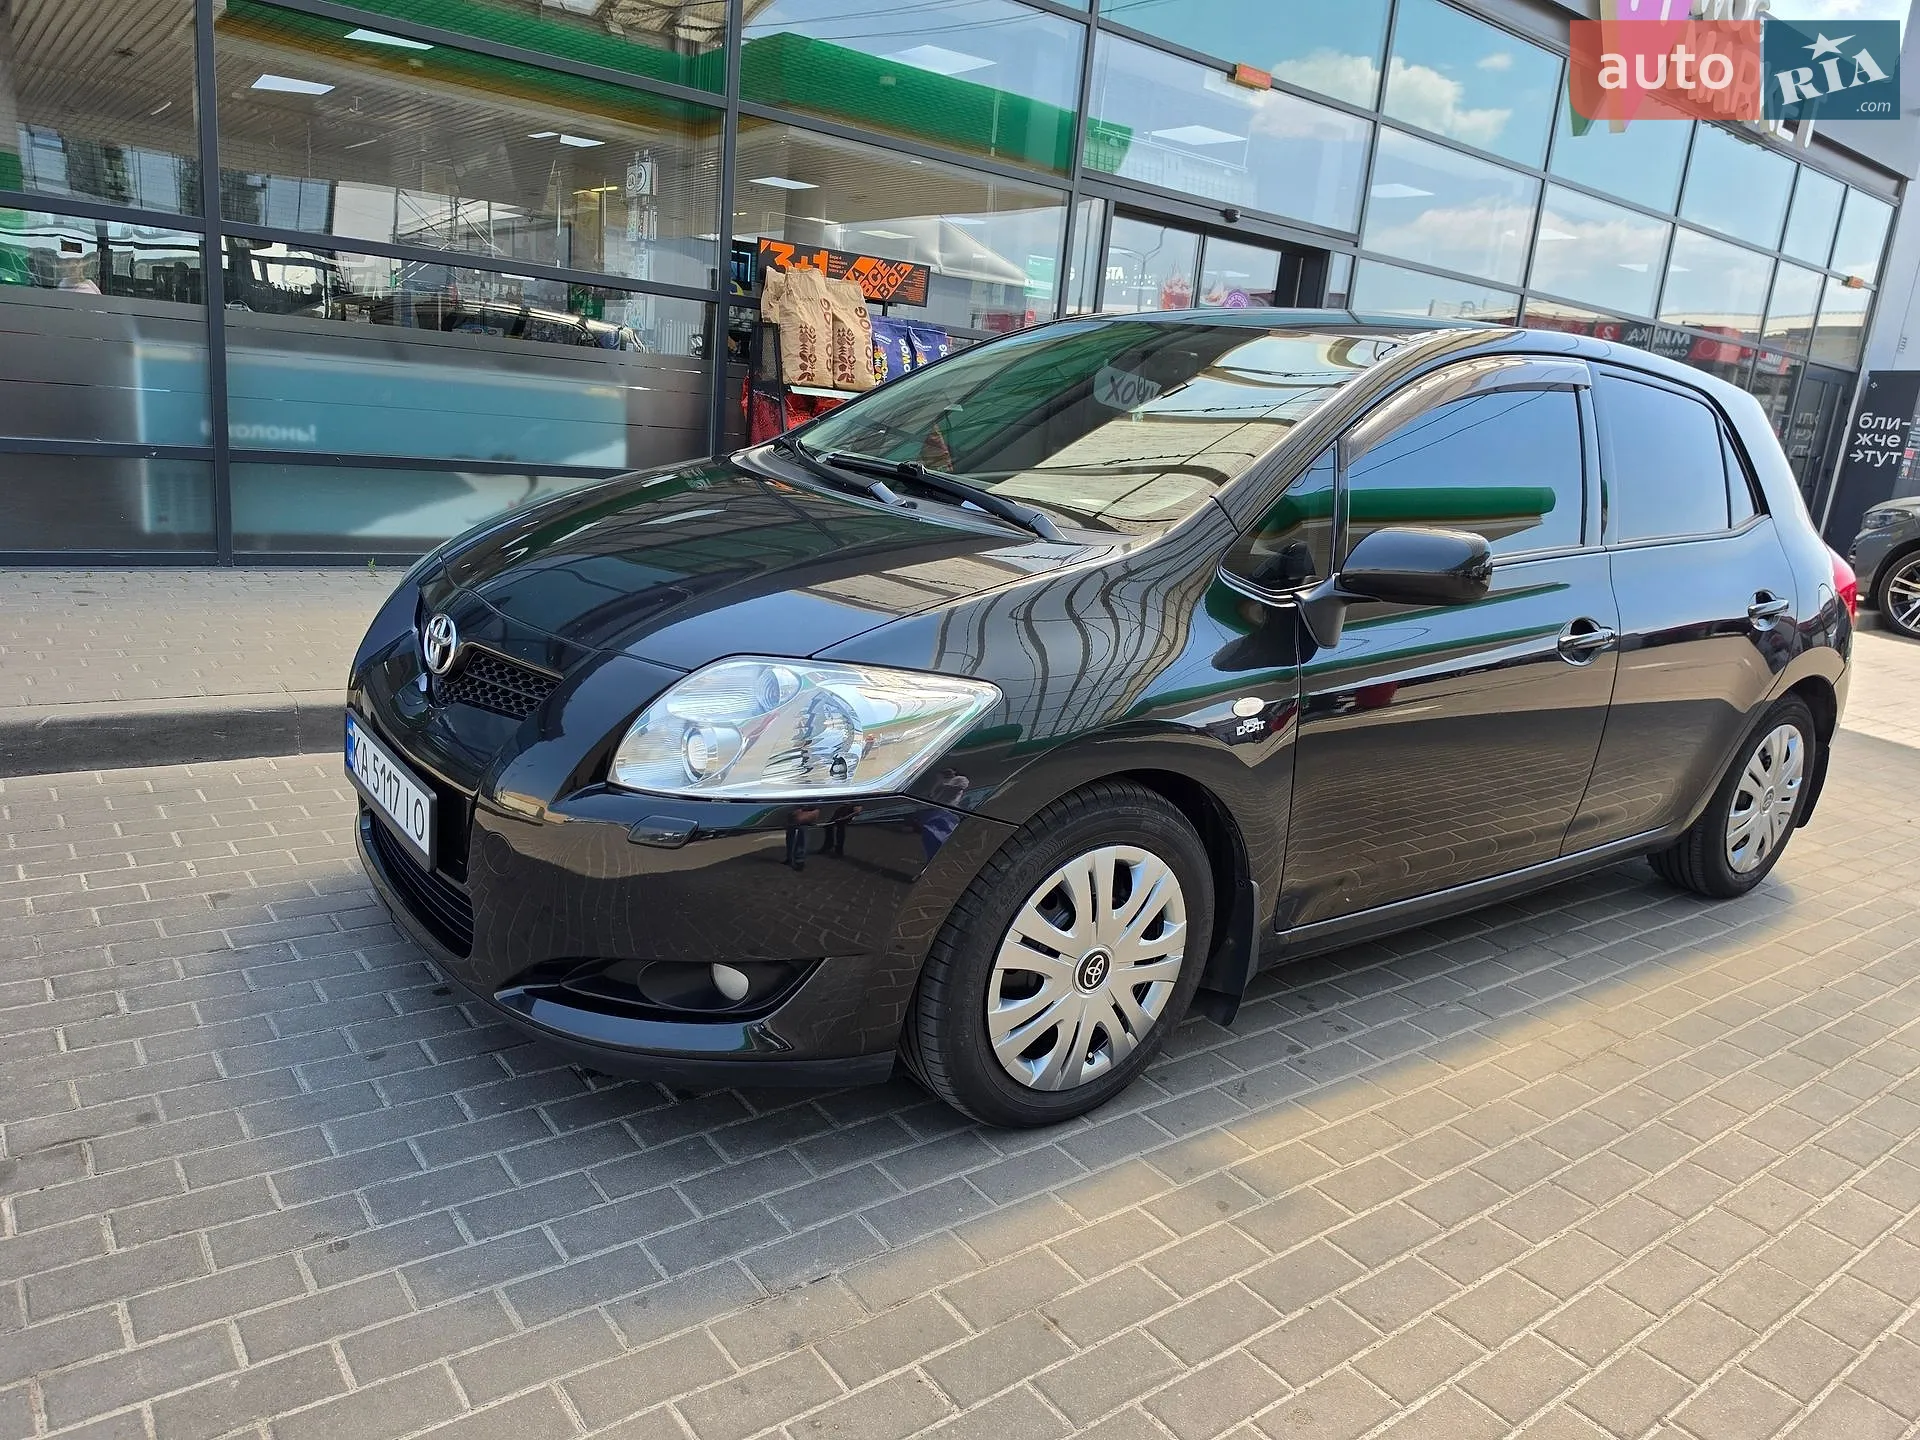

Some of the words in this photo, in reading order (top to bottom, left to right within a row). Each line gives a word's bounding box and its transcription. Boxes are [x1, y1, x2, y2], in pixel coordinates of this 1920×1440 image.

[899, 338, 911, 373] OWOG
[1859, 412, 1911, 431] бли-
[1854, 433, 1901, 448] жче
[1864, 450, 1902, 467] тут
[352, 736, 370, 785] KA
[372, 753, 401, 815] 5117
[405, 787, 425, 842] IO
